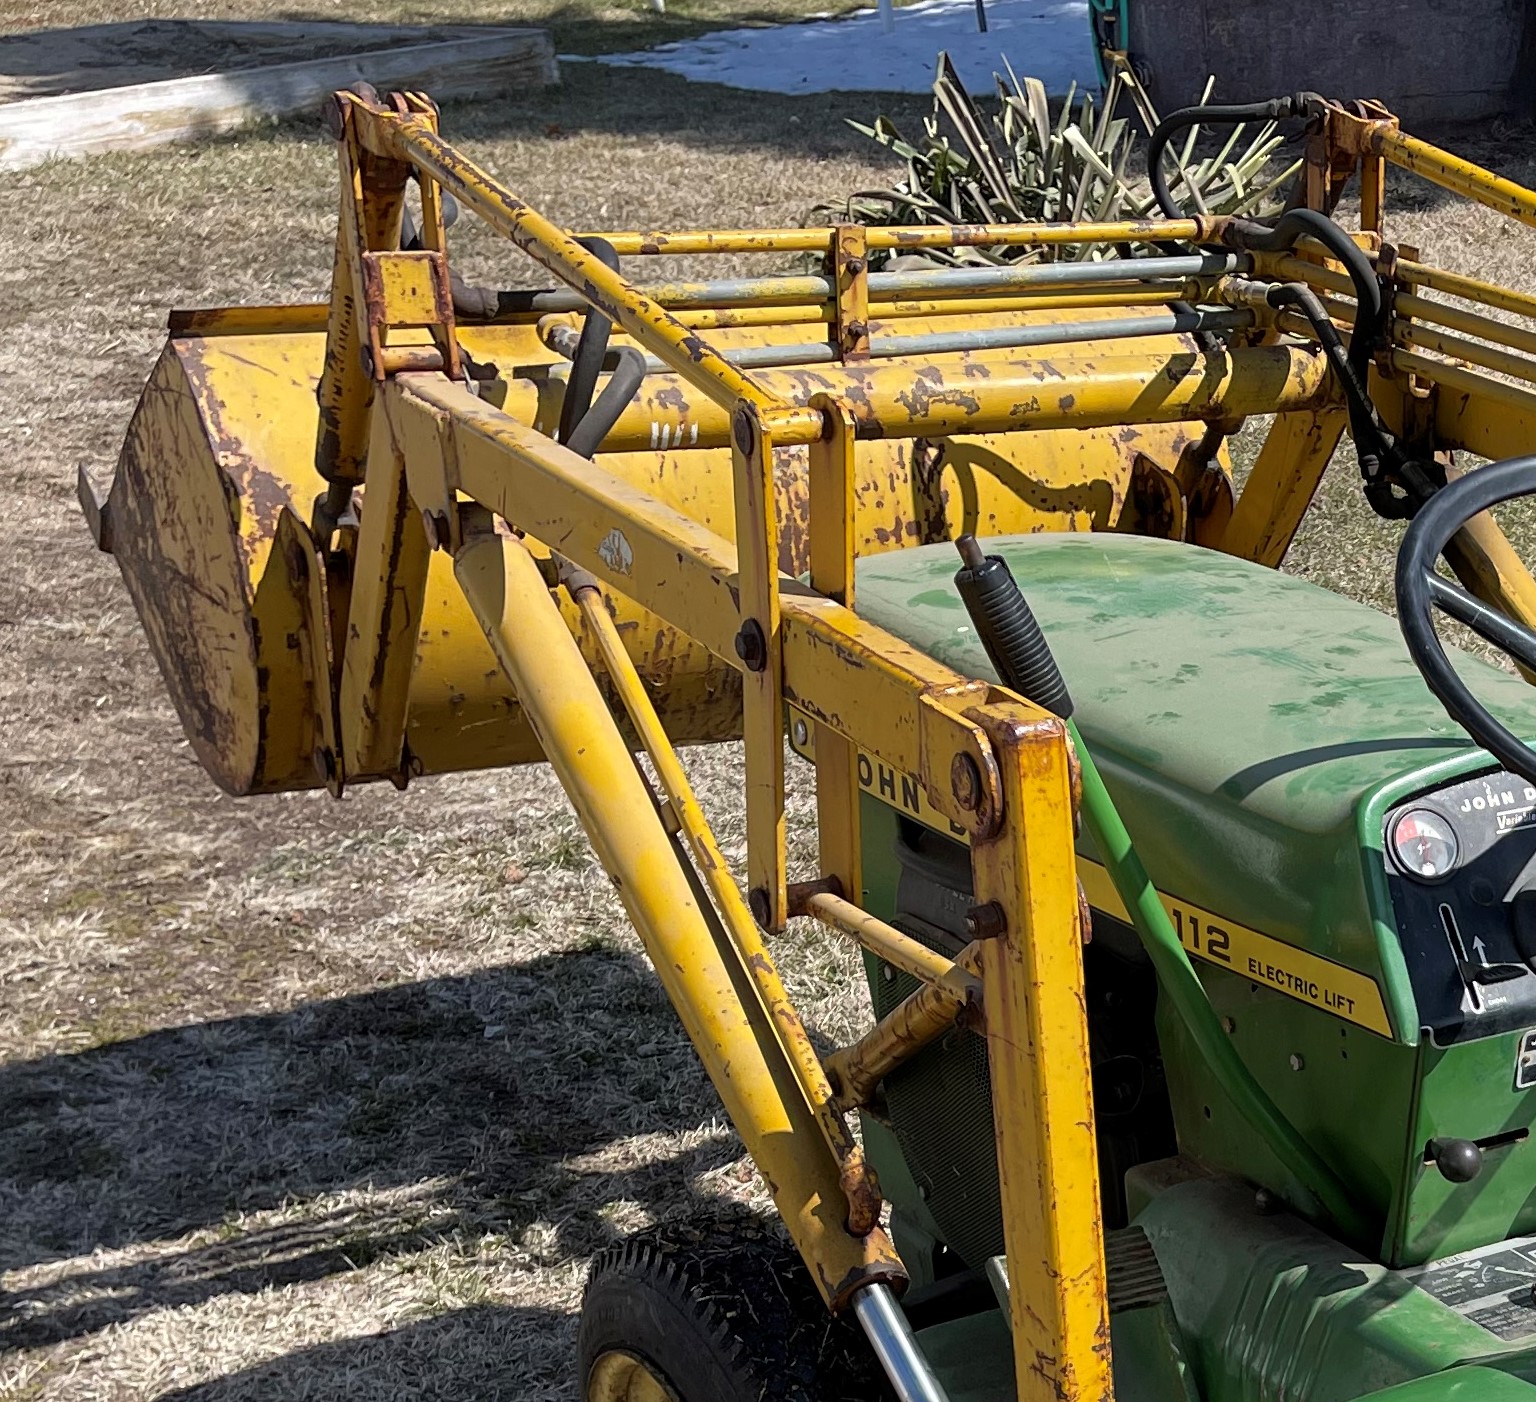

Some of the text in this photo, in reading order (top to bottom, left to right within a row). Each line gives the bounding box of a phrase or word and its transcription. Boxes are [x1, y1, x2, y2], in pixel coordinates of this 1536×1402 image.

[858, 754, 920, 814] OHN
[1460, 790, 1515, 812] JOHN
[1172, 908, 1355, 1015] 112 ELECTRIC LIFT
